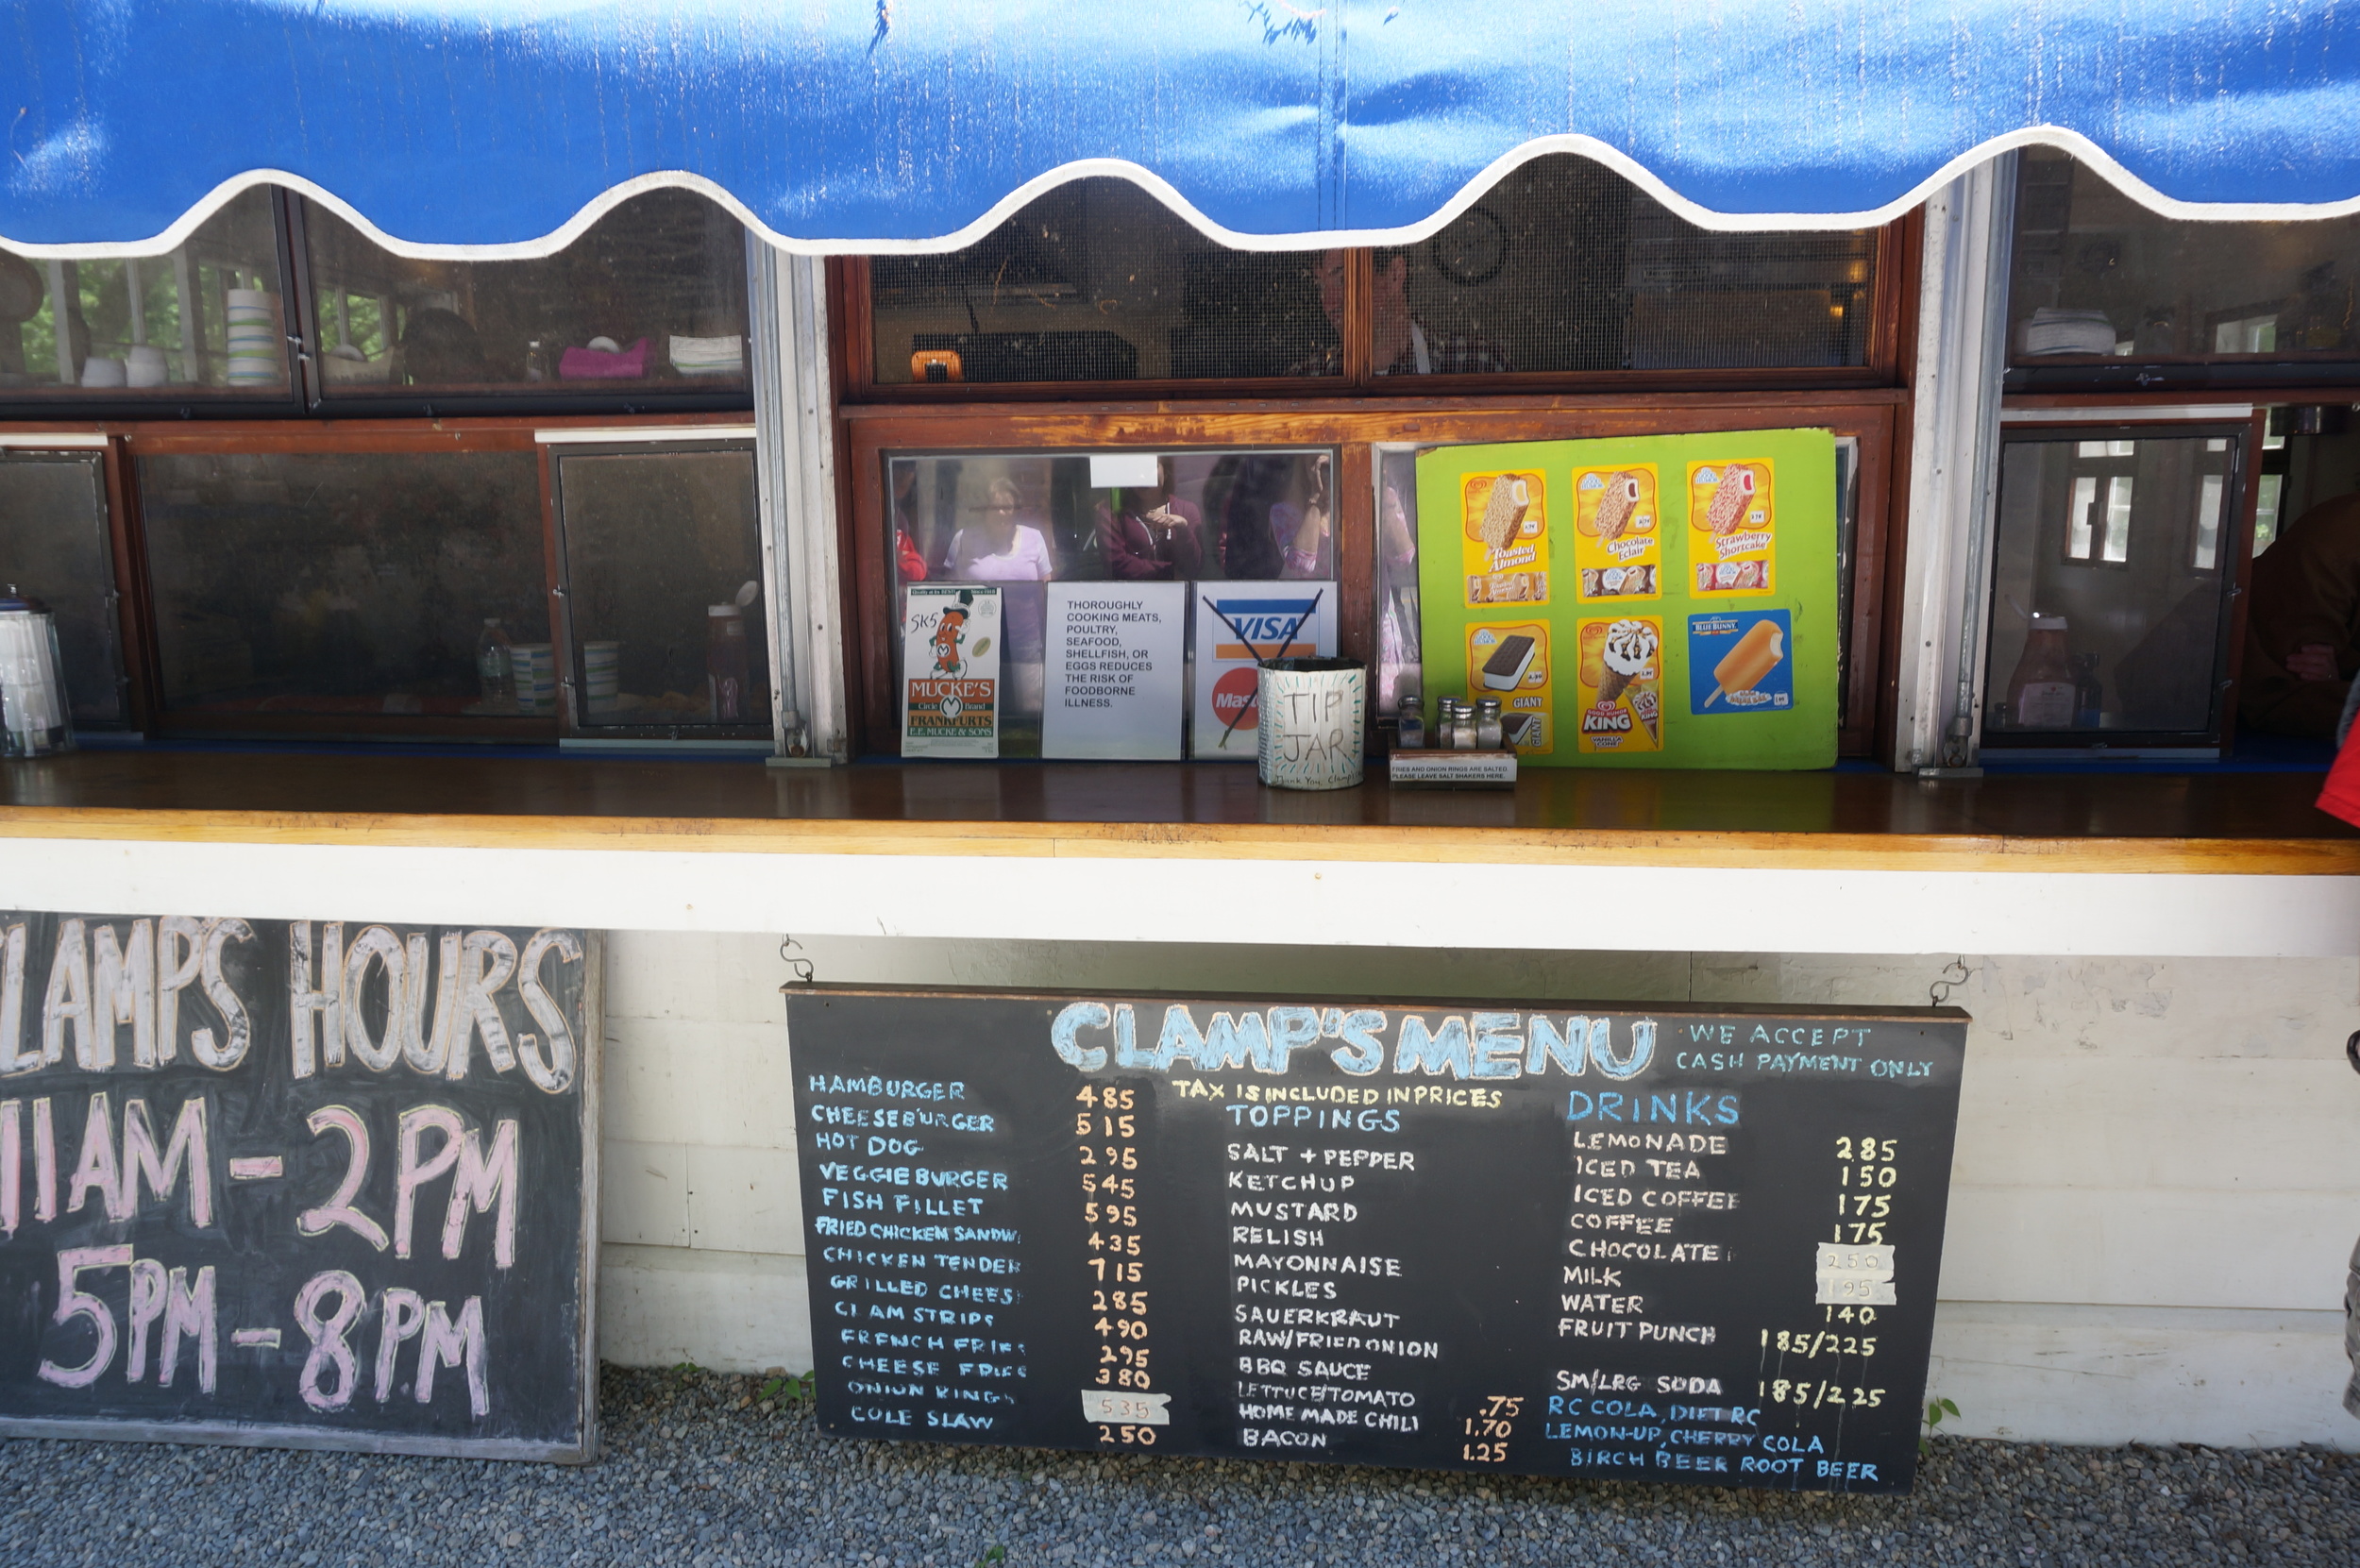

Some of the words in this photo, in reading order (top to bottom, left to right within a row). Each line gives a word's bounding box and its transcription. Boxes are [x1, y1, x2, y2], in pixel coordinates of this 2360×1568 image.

[1608, 536, 1653, 553] Chocolate
[1716, 531, 1771, 548] Strawberry
[1489, 551, 1536, 573] Almond
[1492, 544, 1535, 559] Toasted
[1619, 548, 1644, 561] Eclair
[1719, 542, 1765, 560] Shortcake
[1067, 600, 1143, 610] THOROUGHLY
[1067, 613, 1120, 622] COOKING
[1121, 613, 1162, 624] MEATS,
[1231, 616, 1300, 640] VISA
[1066, 625, 1118, 635] POULTRY,
[1066, 637, 1122, 648] SEAFOOD,
[1066, 649, 1129, 660] SHELLFISH,
[1132, 649, 1149, 658] OR
[1065, 662, 1096, 671] EGGS
[1099, 662, 1153, 670] REDUCES
[1065, 674, 1087, 683] THE
[1089, 674, 1116, 683] RISK
[1119, 674, 1134, 683] OF
[911, 682, 991, 698] MUCKE'S
[1065, 686, 1136, 696] FOODBORNE
[1064, 699, 1113, 708] ILLNESS.
[1283, 690, 1344, 725] TIP
[1513, 698, 1542, 708] GIANT
[910, 715, 992, 726] FRANKFURTS
[927, 727, 957, 735] MUCKE
[968, 727, 992, 735] SONS
[1583, 715, 1631, 731] KING
[1531, 718, 1542, 747] GIANT
[1282, 728, 1349, 764] JAR
[0, 916, 256, 1078] LAMPS
[290, 918, 583, 1095] HOURS
[1051, 1001, 1389, 1077] CLAMP'S
[1391, 1011, 1658, 1081] MENU
[1691, 1024, 1735, 1044] WE
[1750, 1024, 1871, 1046] ACCEPT
[1677, 1053, 1743, 1071] CASH
[1757, 1053, 1859, 1071] PAYMENT
[1870, 1059, 1932, 1078] ONLY
[810, 1075, 964, 1101] HAMBURGER
[1172, 1079, 1224, 1101] TAX
[1266, 1086, 1378, 1104] INCLUDED
[1414, 1086, 1502, 1108] PRICES
[812, 1104, 993, 1132] CHEESEBURGER
[1226, 1104, 1400, 1132] TOPPINGS
[1567, 1090, 1738, 1125] DRINKS
[817, 1132, 858, 1150] HOT
[868, 1136, 920, 1155] DOG
[1574, 1131, 1726, 1154] LEMONADE
[1228, 1143, 1289, 1162] SALT
[1324, 1150, 1414, 1171] PEPPER
[1576, 1155, 1635, 1177] ICED
[1646, 1159, 1699, 1179] TEA
[819, 1162, 909, 1185] VEGGIE
[916, 1168, 1007, 1190] BURGER
[1229, 1171, 1354, 1192] KETCHUP
[822, 1188, 883, 1210] FISH
[894, 1194, 983, 1215] FILLET
[1575, 1185, 1631, 1206] ICED
[1641, 1190, 1741, 1210] COFFEE
[1231, 1202, 1357, 1222] MUSTARD
[815, 1216, 866, 1237] FRIED
[870, 1223, 949, 1241] CHICKEN
[1571, 1214, 1673, 1235] COFFEE
[1233, 1226, 1323, 1246] RELISH
[823, 1247, 925, 1268] CHICKEN
[1569, 1239, 1718, 1262] CHOCOLATE
[1235, 1254, 1402, 1276] MAYONNAISE
[831, 1275, 927, 1297] GRILLED
[1238, 1276, 1337, 1299] PICKLES
[1564, 1266, 1621, 1287] MILK
[1561, 1294, 1643, 1314] WATER
[914, 1307, 993, 1326] STRIPS
[1236, 1305, 1400, 1328] SAUERKRAUT
[38, 1242, 217, 1394] 5PM
[294, 1269, 489, 1416] 8PM
[1559, 1318, 1632, 1339] FRUIT
[1640, 1322, 1715, 1344] PUNCH
[1365, 1339, 1438, 1358] ONION
[842, 1356, 939, 1375] CHEESE
[1239, 1357, 1286, 1374] BBQ
[1298, 1360, 1371, 1380] SAUCE
[848, 1382, 923, 1396] ONION
[1557, 1369, 1641, 1395] SM/LRG
[1658, 1376, 1721, 1394] SODA
[851, 1407, 911, 1425] COLE
[927, 1411, 993, 1429] SLAW
[1239, 1404, 1293, 1420] HOME
[1301, 1408, 1357, 1425] MADE
[1365, 1411, 1418, 1432] CHILI
[1549, 1395, 1582, 1415] RC
[1671, 1405, 1725, 1421] DIET
[1727, 1407, 1760, 1425] RC
[1243, 1428, 1325, 1447] BACON
[1670, 1429, 1755, 1446] CHERRY
[1763, 1435, 1824, 1454] COLA
[1571, 1448, 1644, 1466] BIRCH
[1656, 1450, 1728, 1472] BEER
[1741, 1457, 1804, 1473] ROOT
[1817, 1460, 1878, 1481] BEER
